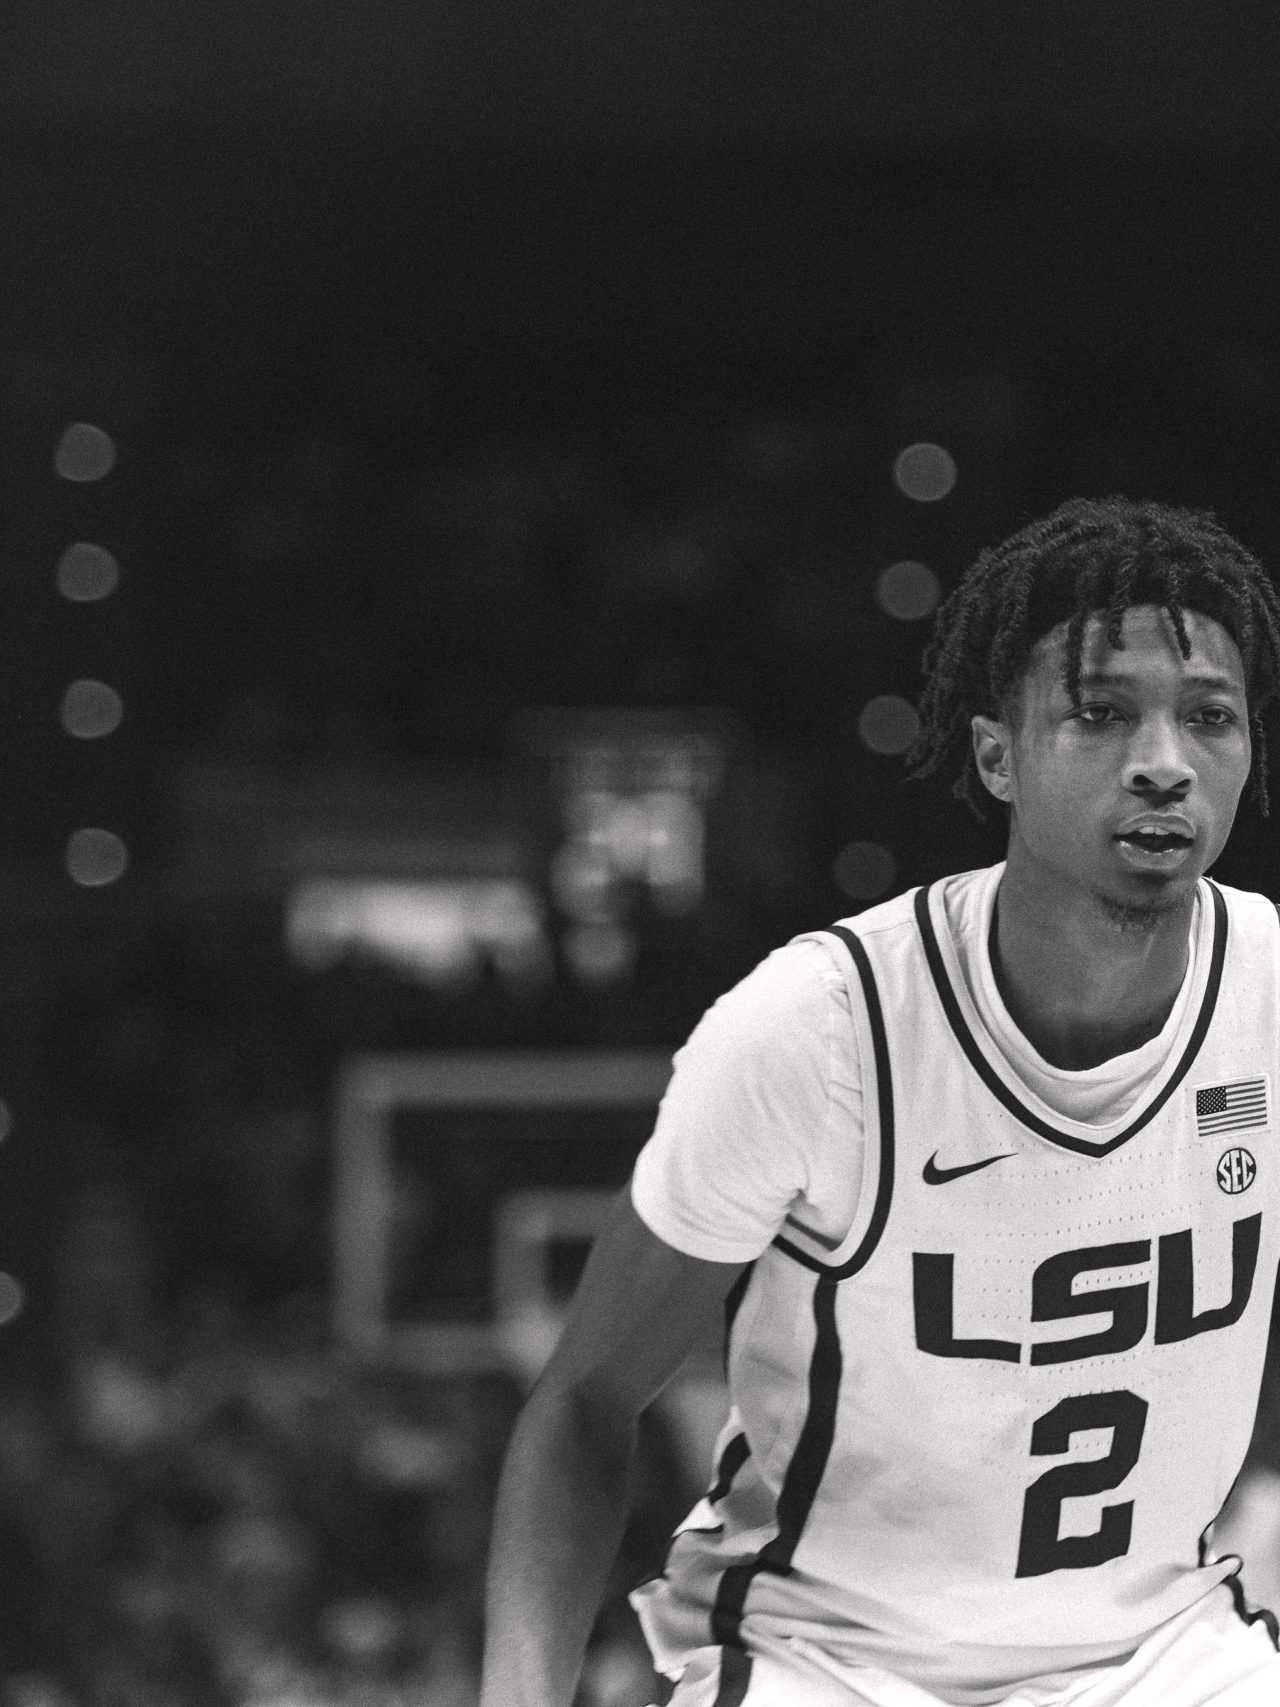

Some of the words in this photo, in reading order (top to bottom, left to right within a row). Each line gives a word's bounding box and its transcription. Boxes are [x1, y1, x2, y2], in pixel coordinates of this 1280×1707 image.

[1218, 1149, 1255, 1193] SEC
[912, 1211, 1263, 1367] LSU
[1014, 1389, 1149, 1579] 2
